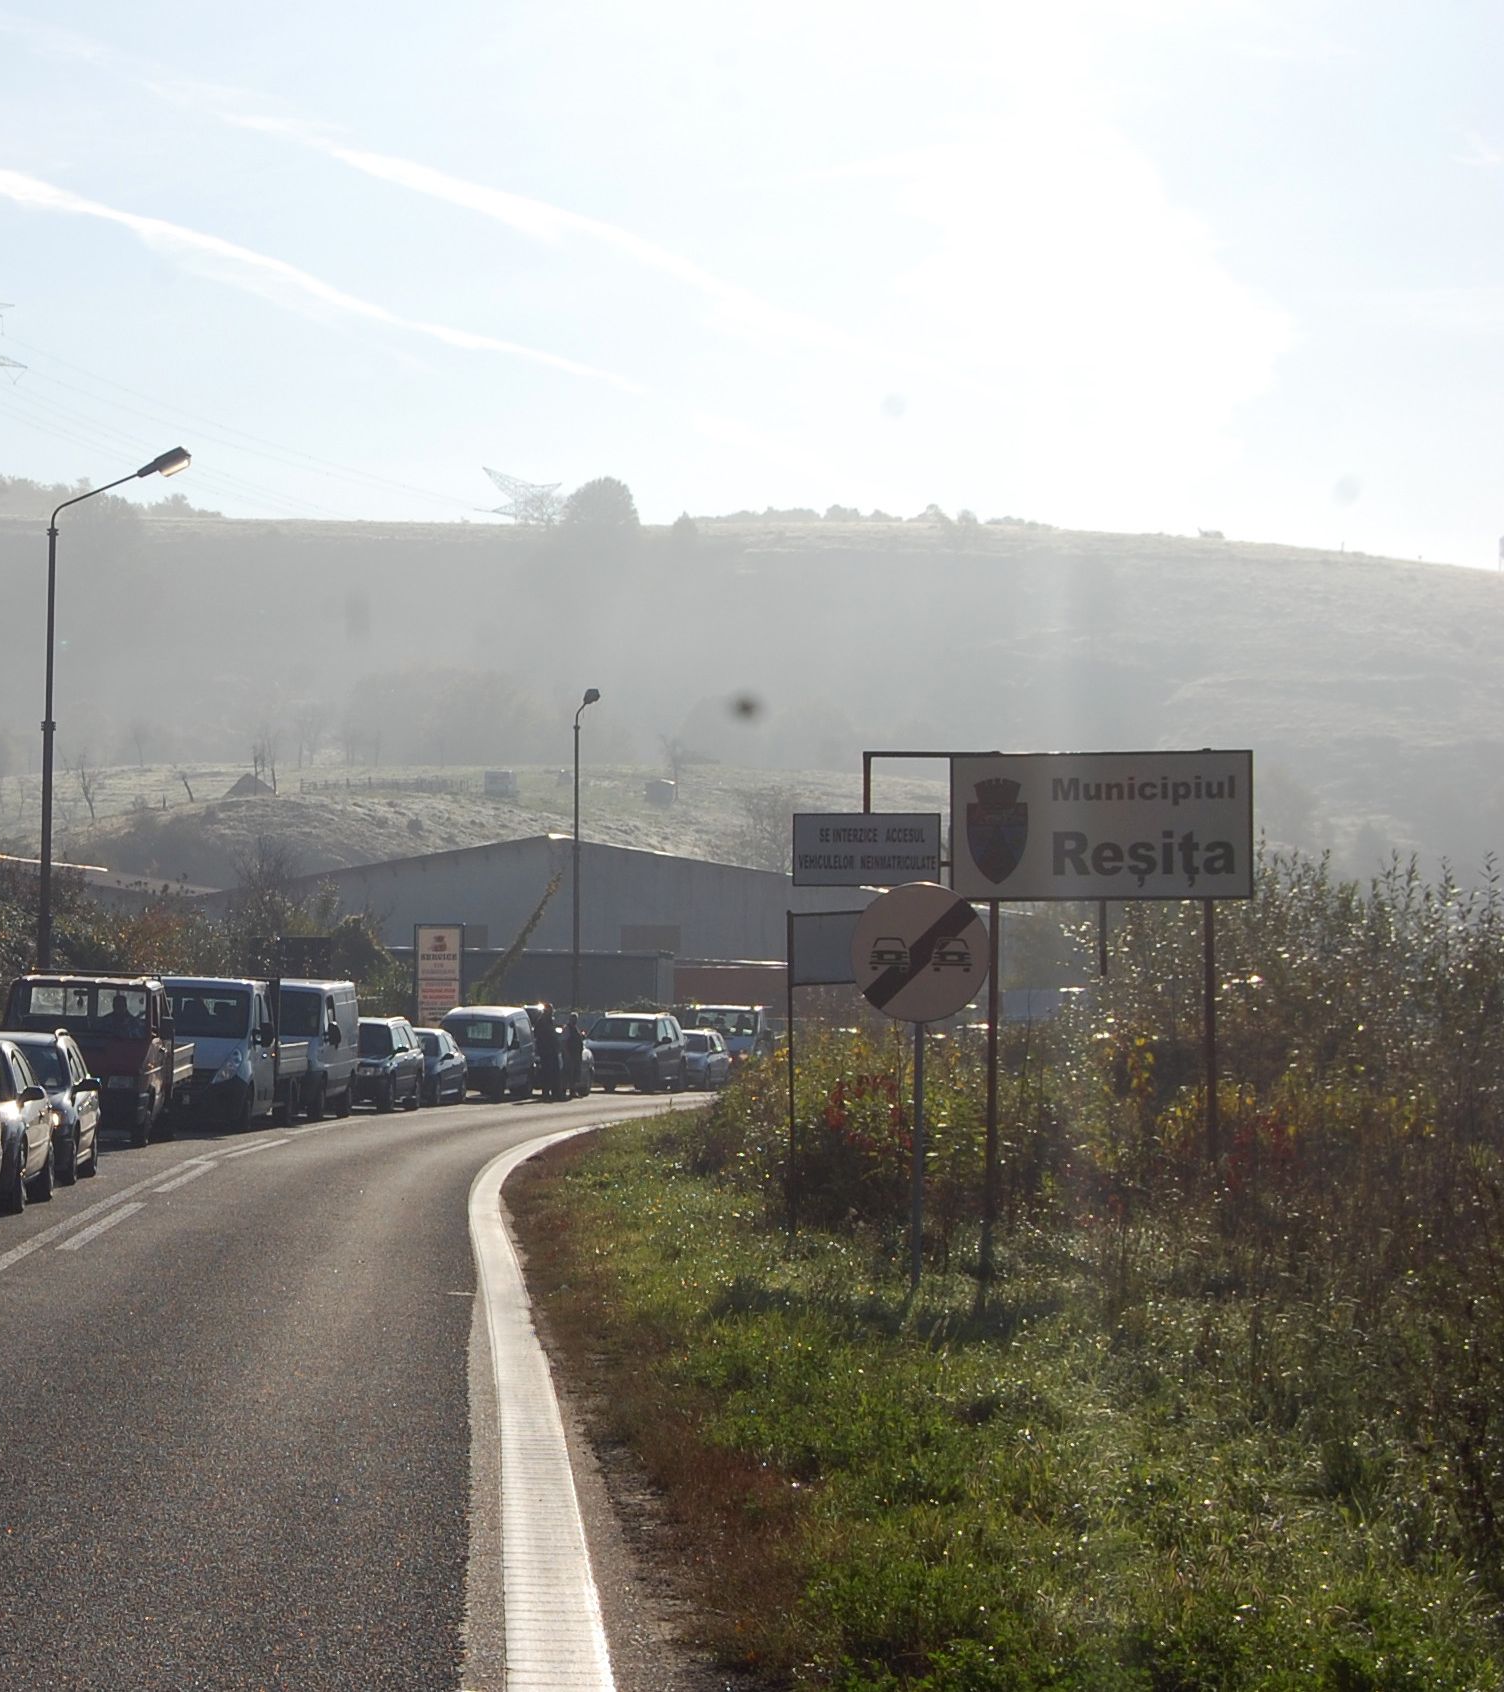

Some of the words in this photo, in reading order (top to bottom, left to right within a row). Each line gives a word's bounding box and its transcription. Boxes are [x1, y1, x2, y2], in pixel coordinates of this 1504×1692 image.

[1052, 775, 1236, 807] Municipiul
[818, 828, 831, 843] SE
[833, 828, 878, 843] INTERZICE
[886, 828, 926, 843] ACCESUL
[798, 854, 854, 870] VEHICULELOR
[860, 855, 937, 871] NEINMATRICULATE
[1052, 829, 1236, 888] Reșița
[421, 953, 457, 961] SERVICE
